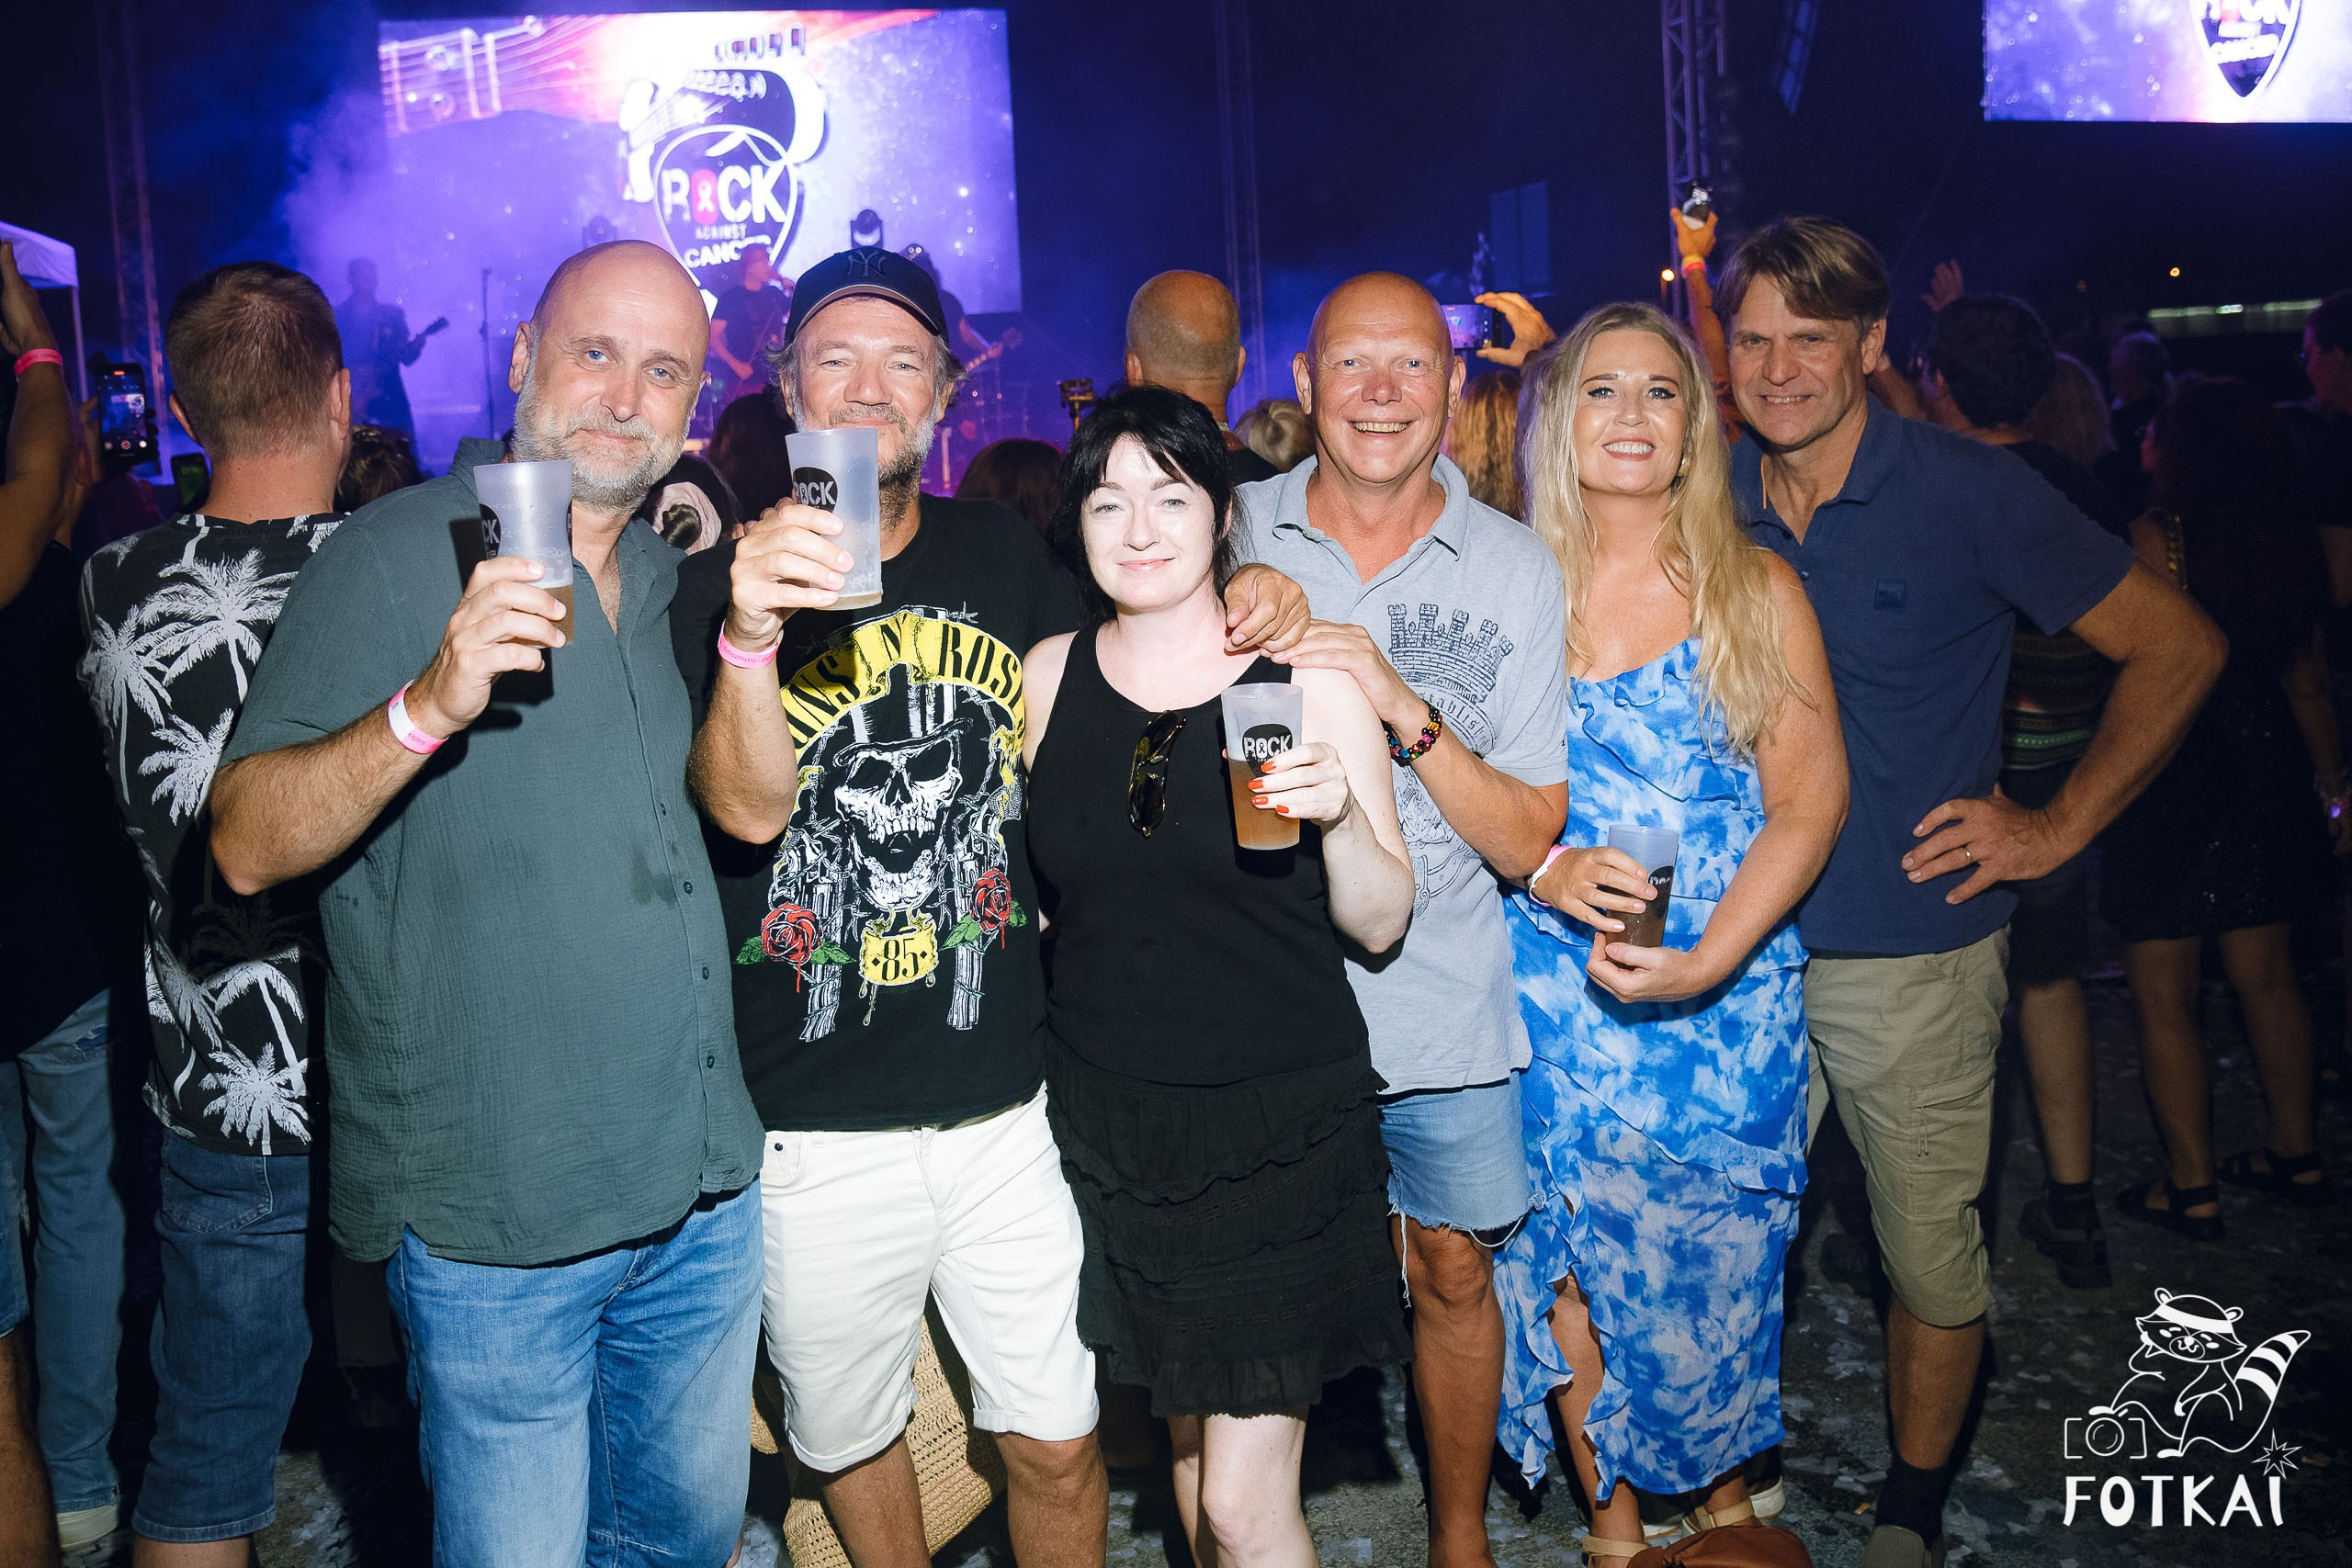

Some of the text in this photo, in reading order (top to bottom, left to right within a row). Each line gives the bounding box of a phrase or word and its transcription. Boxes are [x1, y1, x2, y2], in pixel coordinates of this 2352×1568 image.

[661, 164, 788, 224] ROCK
[481, 519, 501, 545] CK
[782, 655, 861, 750] UNS
[1243, 734, 1292, 759] ROCK
[881, 937, 920, 982] 85
